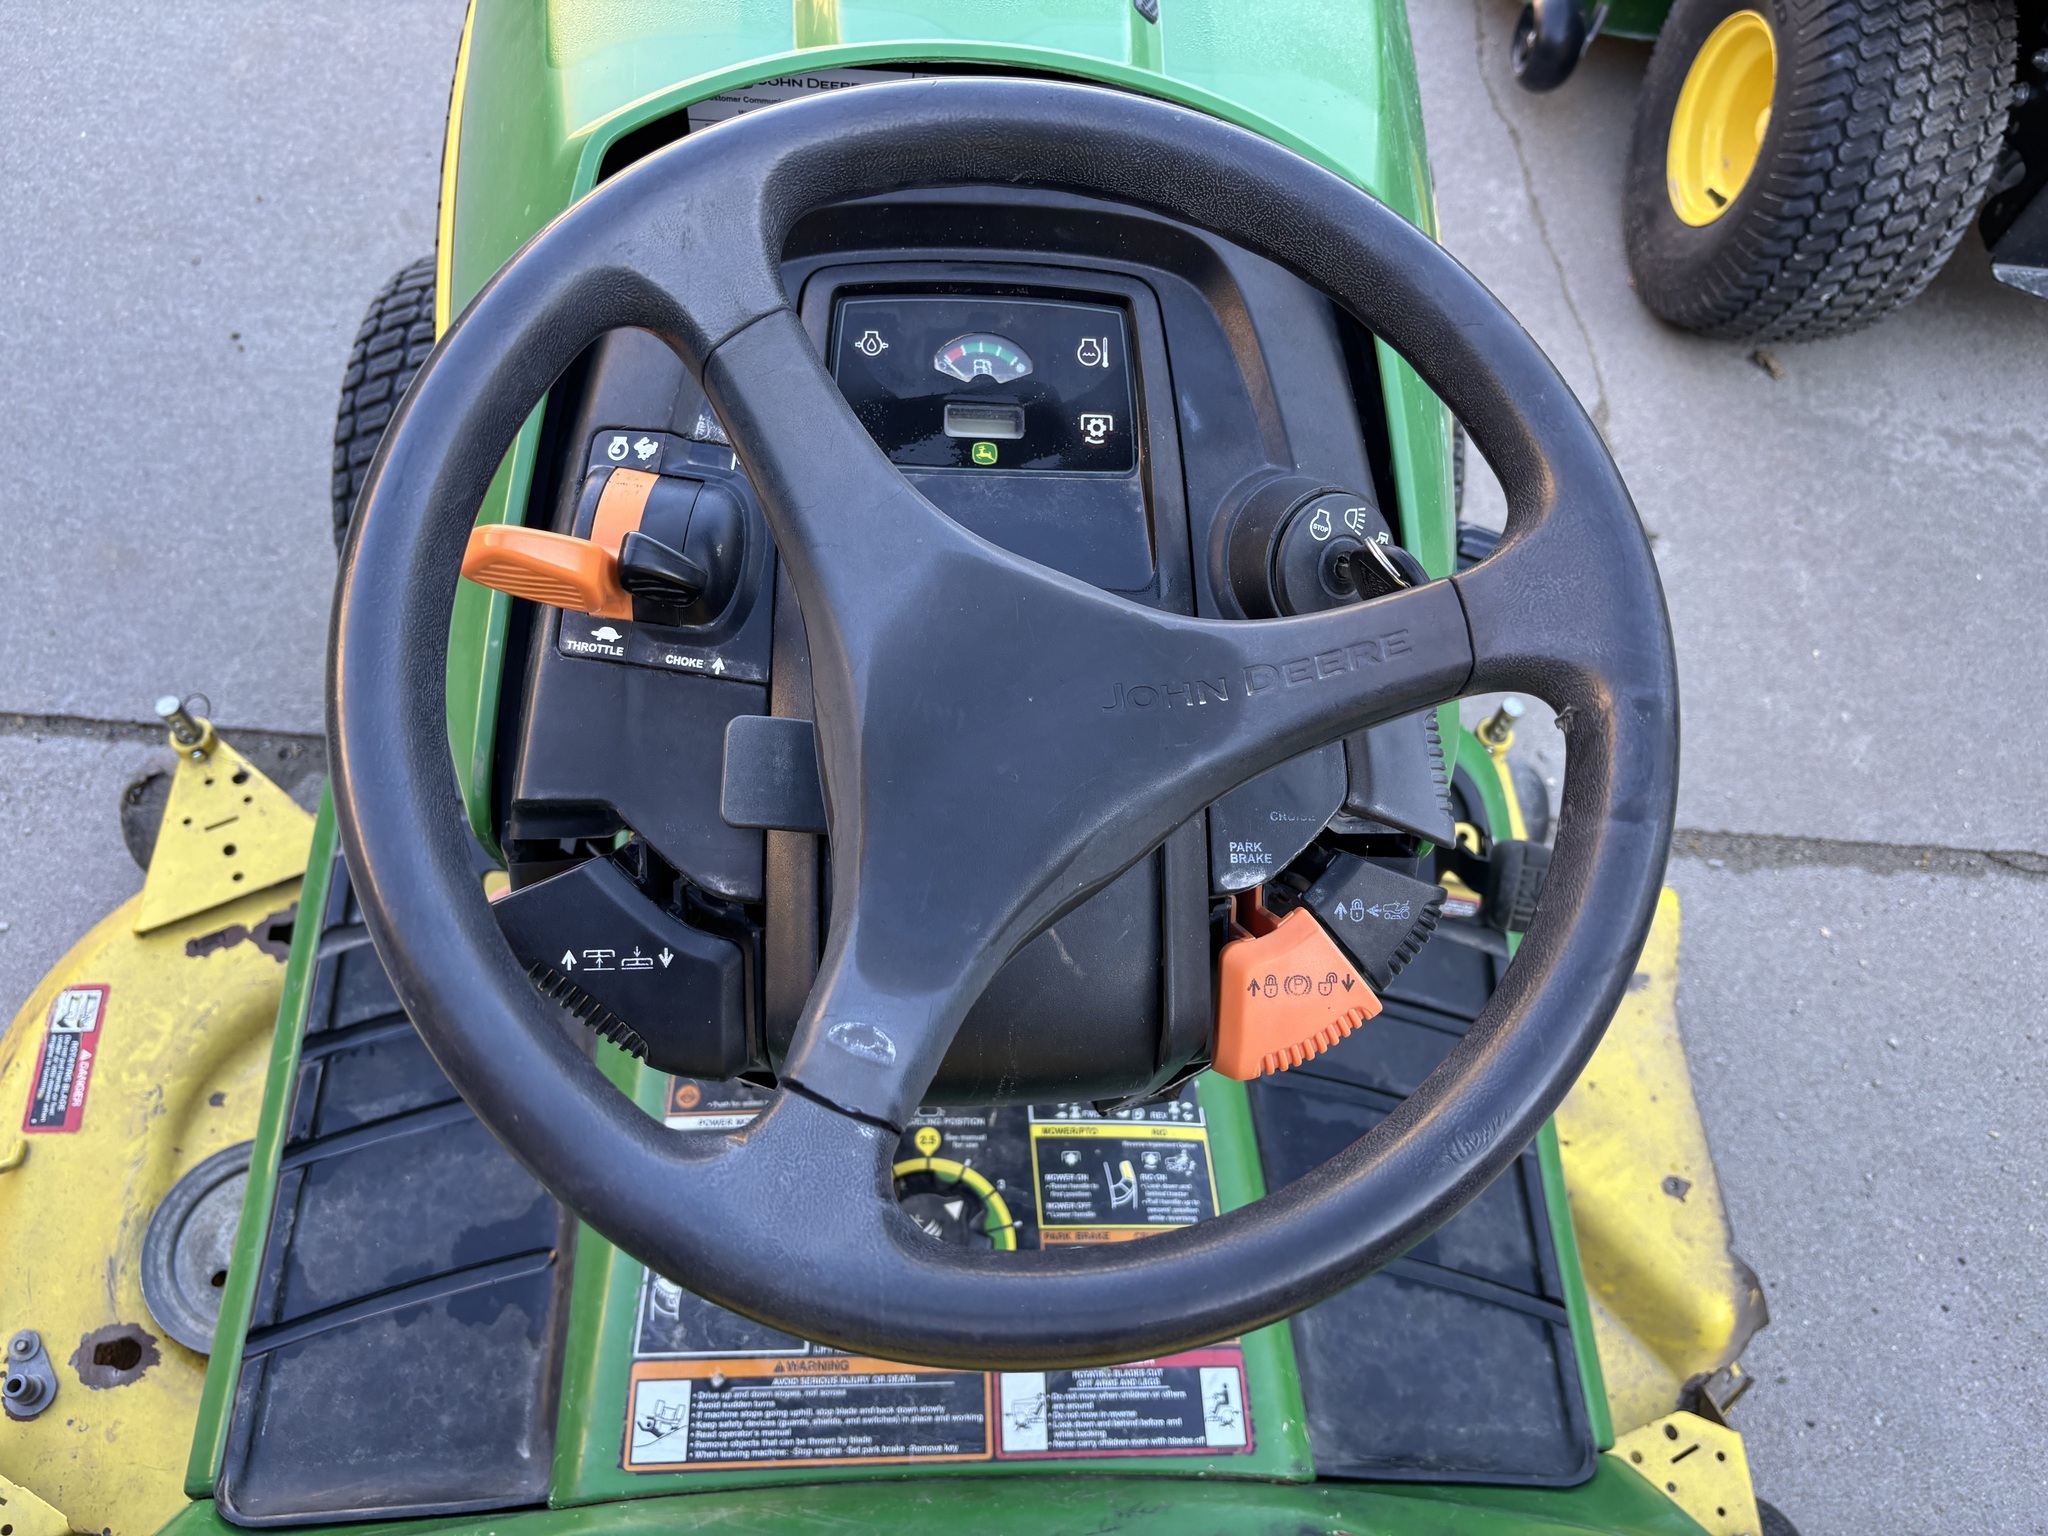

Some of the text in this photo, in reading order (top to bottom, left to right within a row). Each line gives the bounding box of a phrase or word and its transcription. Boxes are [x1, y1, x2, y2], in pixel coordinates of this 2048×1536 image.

[759, 77, 861, 90] OHN DEER
[1312, 523, 1329, 533] STOP
[567, 640, 624, 656] THROTTLE
[665, 655, 704, 669] CHOKE
[1101, 628, 1413, 713] JOHN DEERE
[1229, 841, 1263, 853] PARK
[1230, 853, 1273, 865] BRAKE
[57, 1040, 79, 1112] ROTATING BLADE
[72, 1061, 90, 1107] DANGER
[943, 1117, 986, 1127] POSITION
[997, 1179, 1006, 1190] 3
[1044, 1232, 1110, 1240] PARK BRAKE
[786, 1359, 849, 1371] WARNING
[771, 1374, 916, 1386] AVOID SERIOUS INJURY OR DEATH
[704, 1410, 739, 1419] machine
[761, 1429, 792, 1437] manual
[695, 1440, 729, 1448] Remove
[730, 1440, 760, 1449] objects
